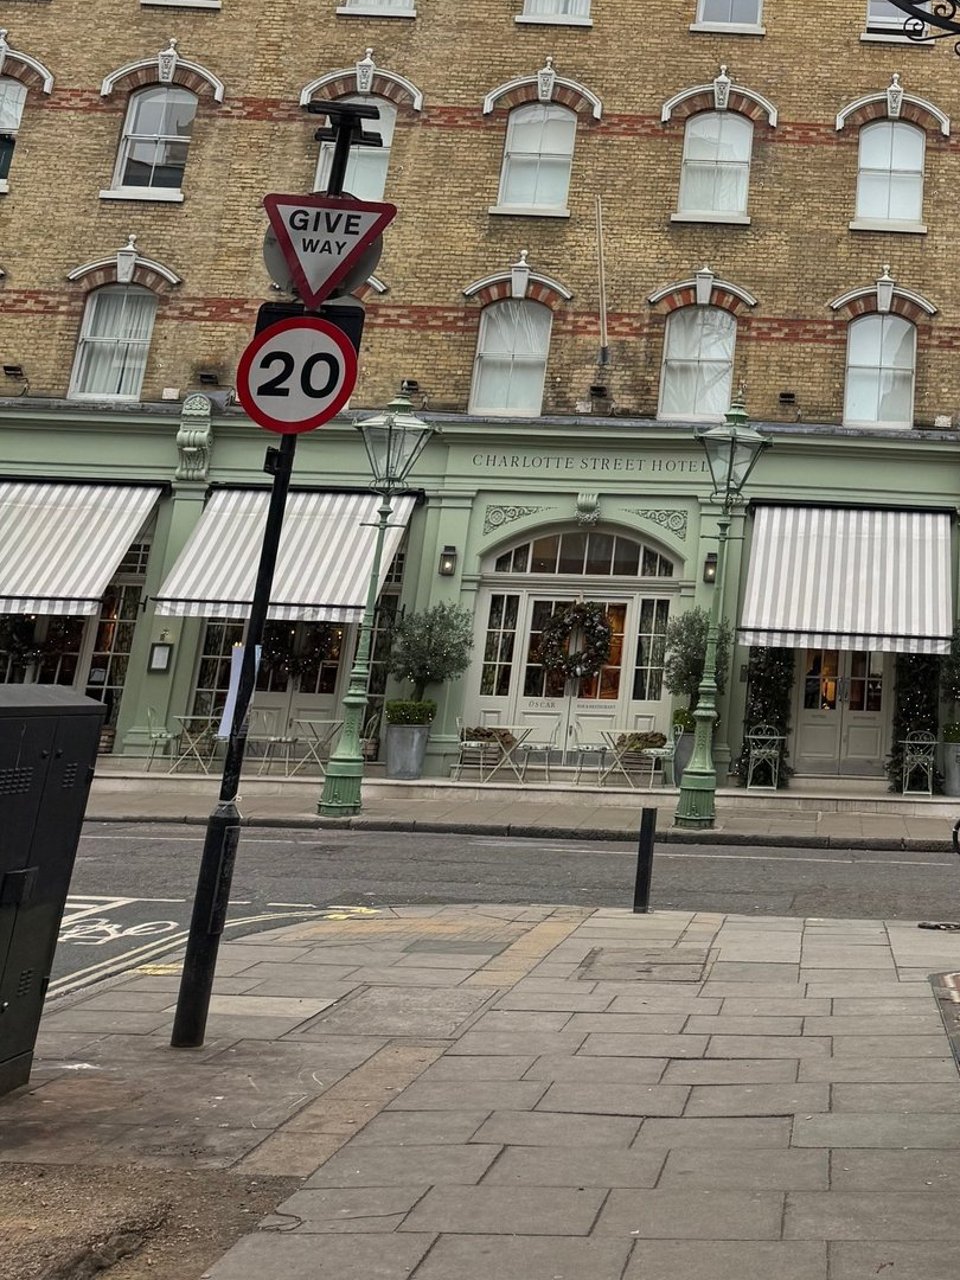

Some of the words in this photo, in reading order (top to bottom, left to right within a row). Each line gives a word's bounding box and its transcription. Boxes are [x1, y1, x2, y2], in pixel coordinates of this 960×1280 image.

[289, 209, 362, 236] GIVE
[302, 238, 347, 256] WAY
[256, 350, 340, 399] 20
[472, 453, 575, 469] CHARLOTTE
[579, 457, 646, 471] STREET
[651, 460, 709, 473] HOTEL
